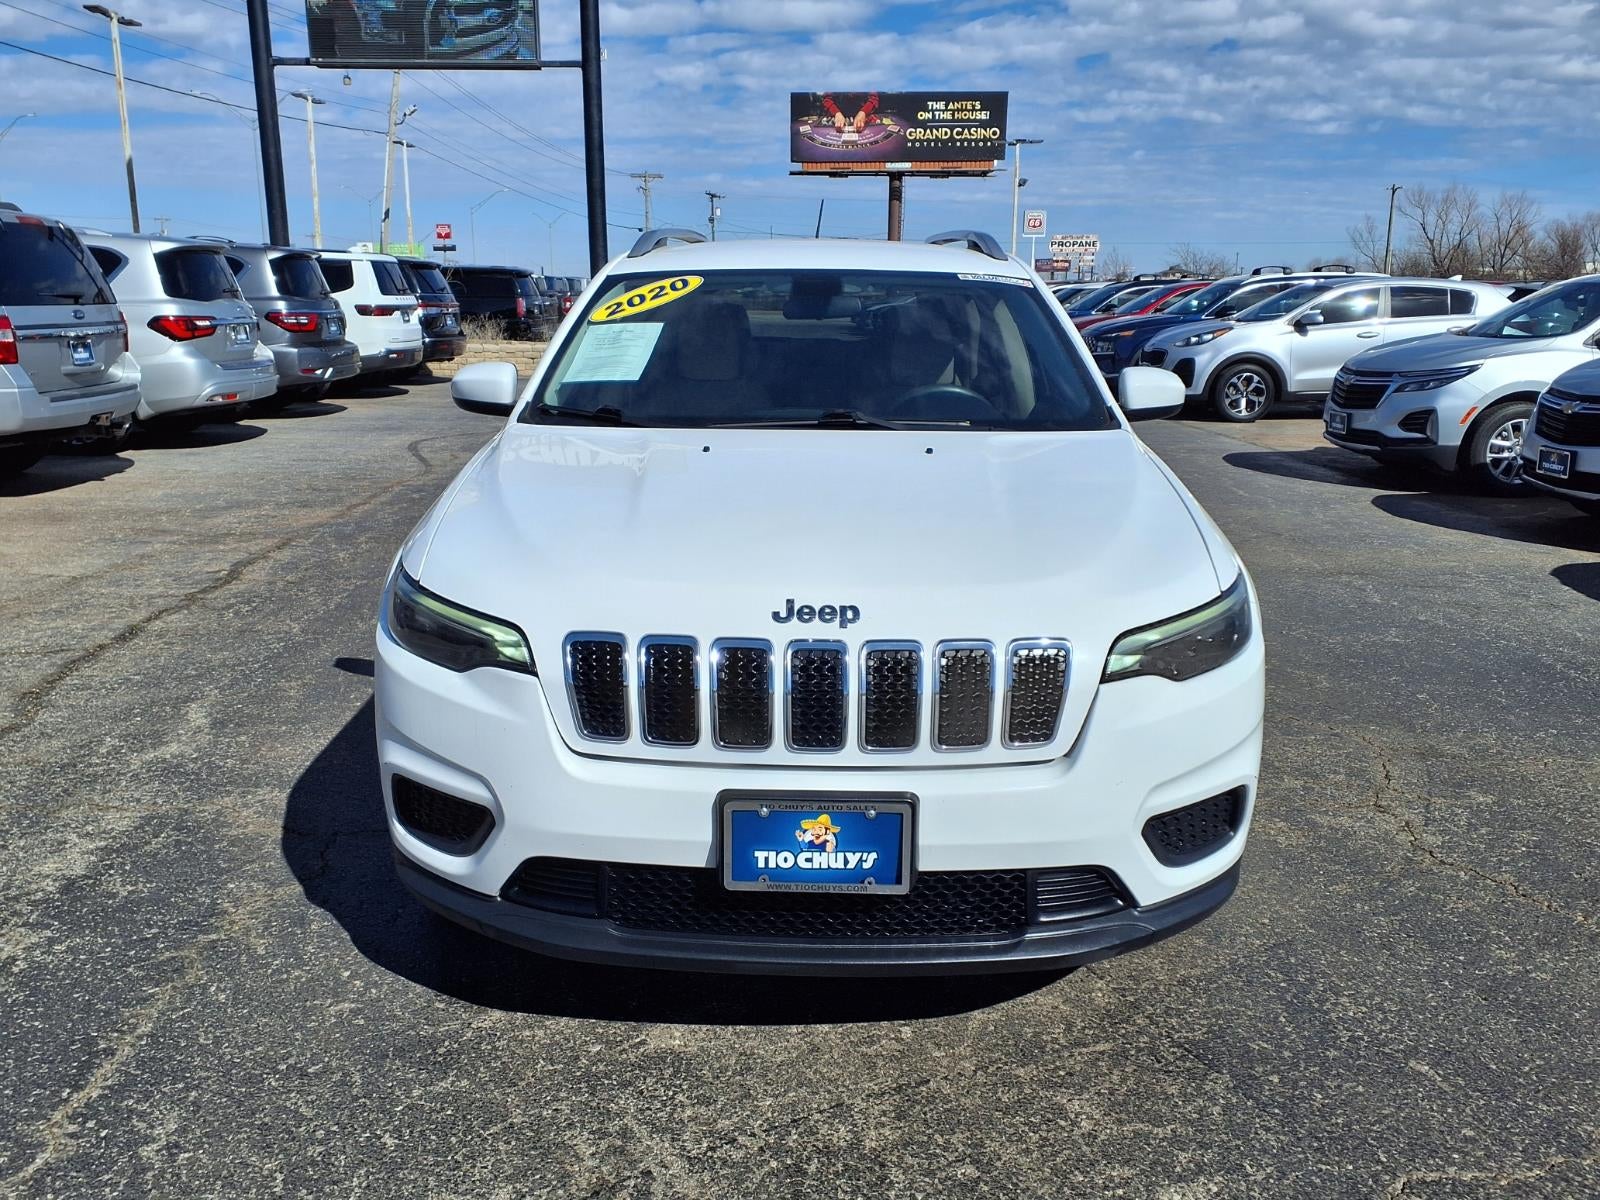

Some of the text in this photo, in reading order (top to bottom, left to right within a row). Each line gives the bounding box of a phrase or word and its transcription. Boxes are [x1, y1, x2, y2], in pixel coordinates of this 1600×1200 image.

[927, 101, 981, 110] THE ANTE'S
[917, 111, 990, 120] ON THE HOUSE!
[906, 127, 1000, 140] GRAND CASINO
[1029, 219, 1041, 227] 66
[1050, 240, 1098, 248] PROPANE
[604, 278, 690, 318] 2020
[771, 598, 861, 629] Jeep
[778, 803, 814, 811] CHUY'S
[846, 804, 878, 812] SALES
[766, 883, 869, 893] WWW.TIOCHUYS.COM
